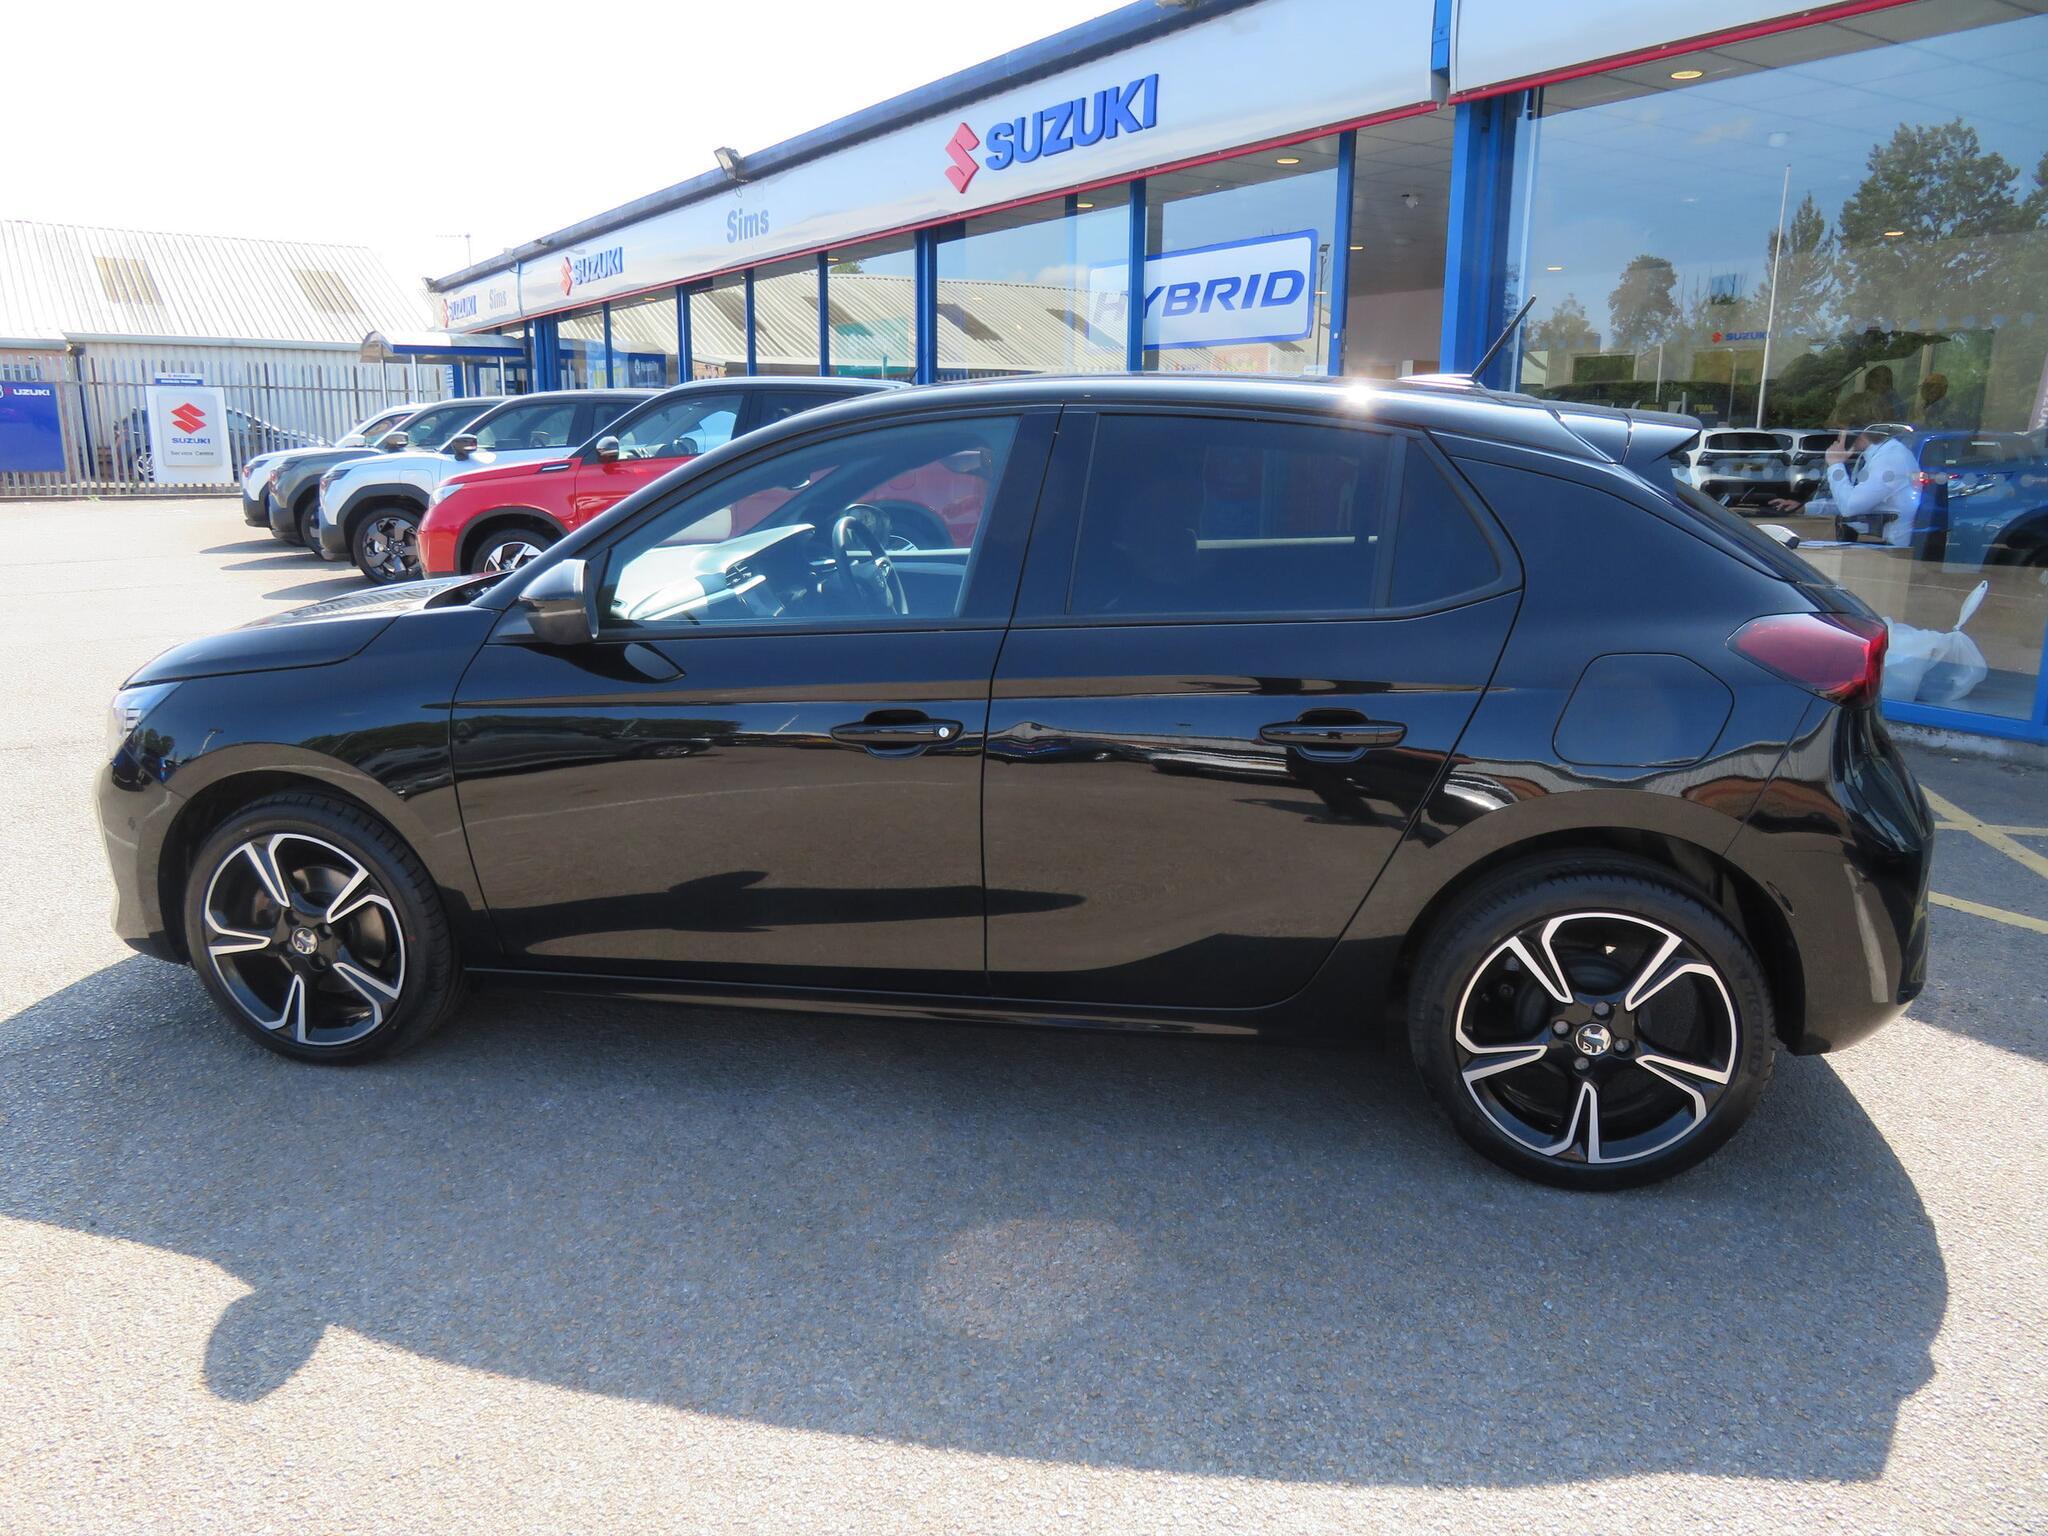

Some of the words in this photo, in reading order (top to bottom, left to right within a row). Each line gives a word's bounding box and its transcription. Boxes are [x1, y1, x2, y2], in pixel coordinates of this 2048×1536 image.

[985, 73, 1159, 171] SUZUKI
[726, 208, 770, 243] Sims
[573, 247, 624, 285] SUZUKI
[449, 294, 477, 321] SUZUKI
[489, 287, 507, 310] Sims
[1726, 331, 1772, 341] SUZUK
